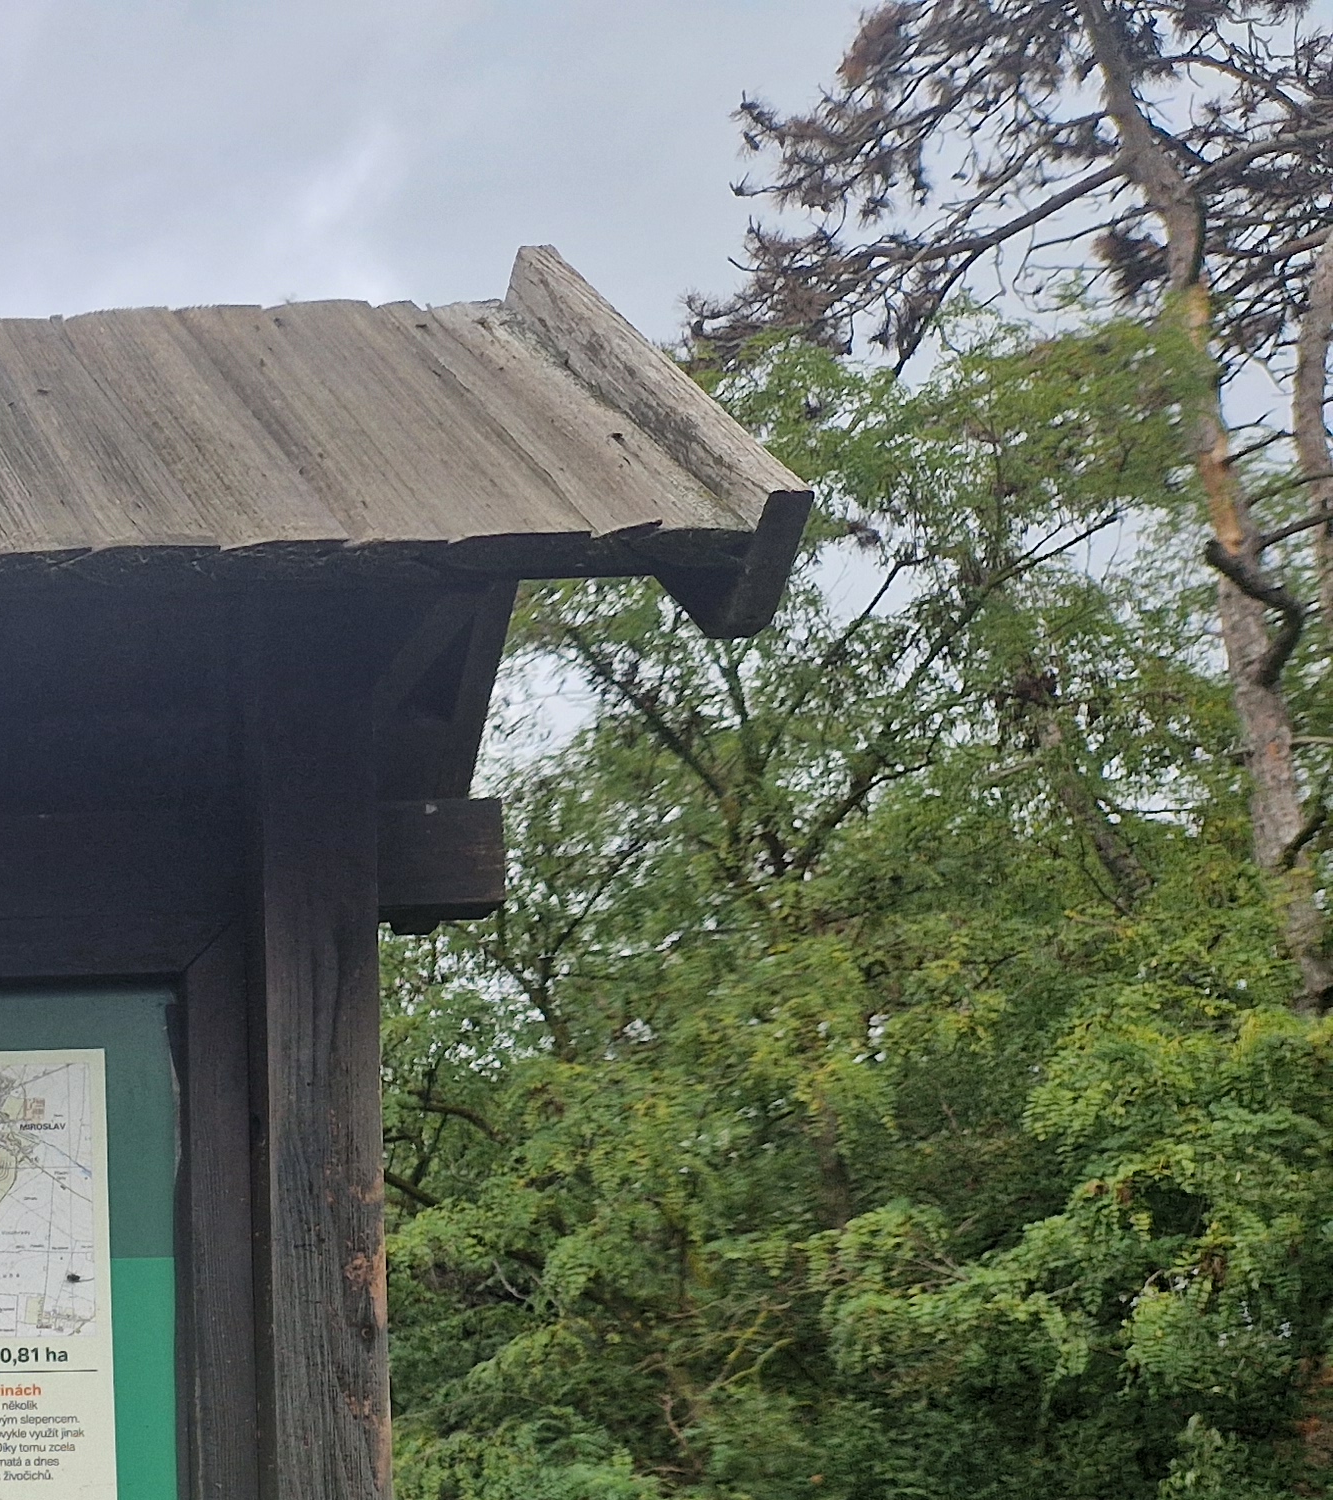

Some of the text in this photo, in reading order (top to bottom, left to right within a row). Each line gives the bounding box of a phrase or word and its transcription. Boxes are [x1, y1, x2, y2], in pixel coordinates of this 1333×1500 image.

[19, 1122, 66, 1131] MIROSLAV
[45, 1347, 67, 1362] ha
[1, 1400, 38, 1410] několik
[20, 1414, 79, 1425] slepencem.
[28, 1427, 58, 1440] využít
[60, 1427, 84, 1439] jinak
[18, 1443, 46, 1452] tomu
[48, 1442, 75, 1452] zcela
[24, 1458, 31, 1466] a
[33, 1456, 59, 1466] dnes
